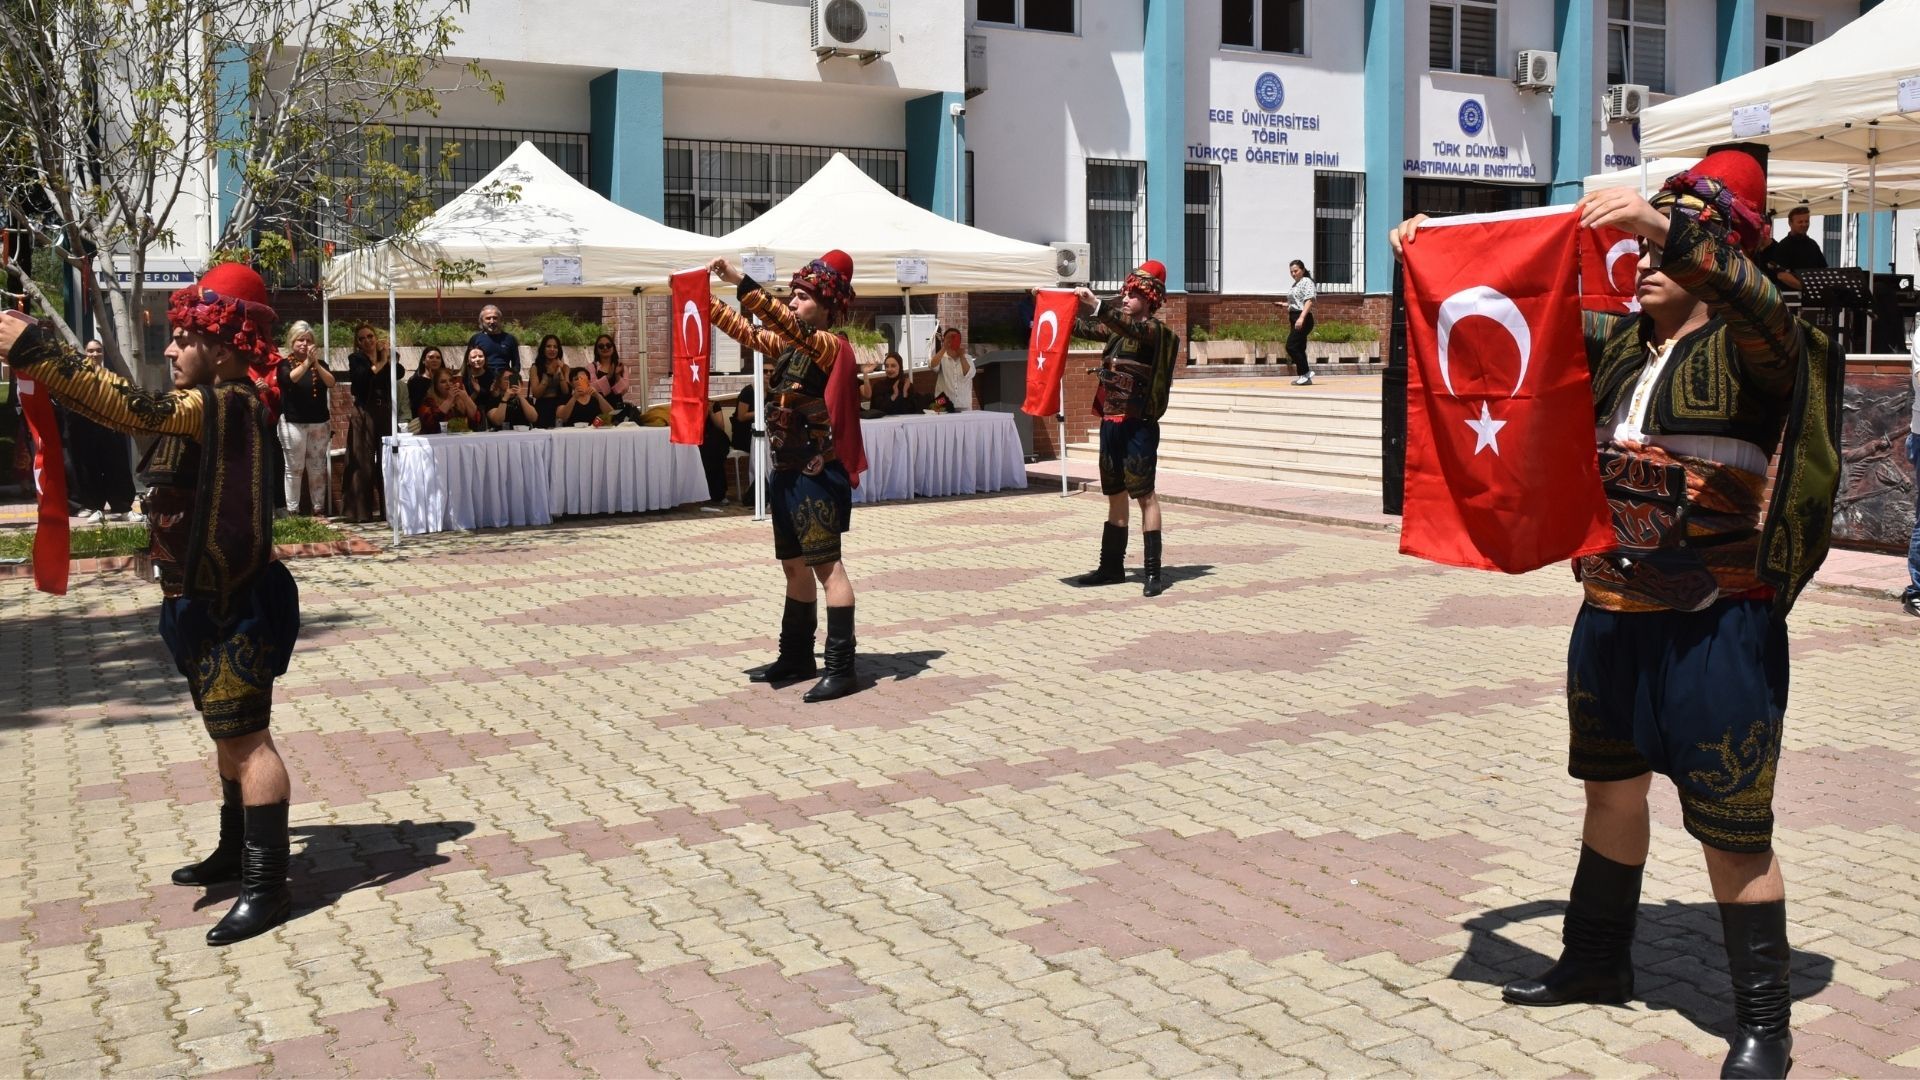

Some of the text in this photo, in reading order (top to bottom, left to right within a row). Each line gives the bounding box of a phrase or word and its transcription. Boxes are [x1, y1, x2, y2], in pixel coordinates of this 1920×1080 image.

[1209, 108, 1319, 130] EGE ÜNİVERSİTESİ
[1252, 128, 1287, 144] TÖBİR
[1188, 143, 1339, 166] TÜRKÇE ÖĞRETİM BİRİMİ
[1433, 141, 1508, 159] TÜRK DÜNYASI
[1605, 154, 1637, 167] SOSYAL
[1484, 163, 1536, 177] ENSTİTÜSÜ
[117, 273, 180, 282] TEEFON
